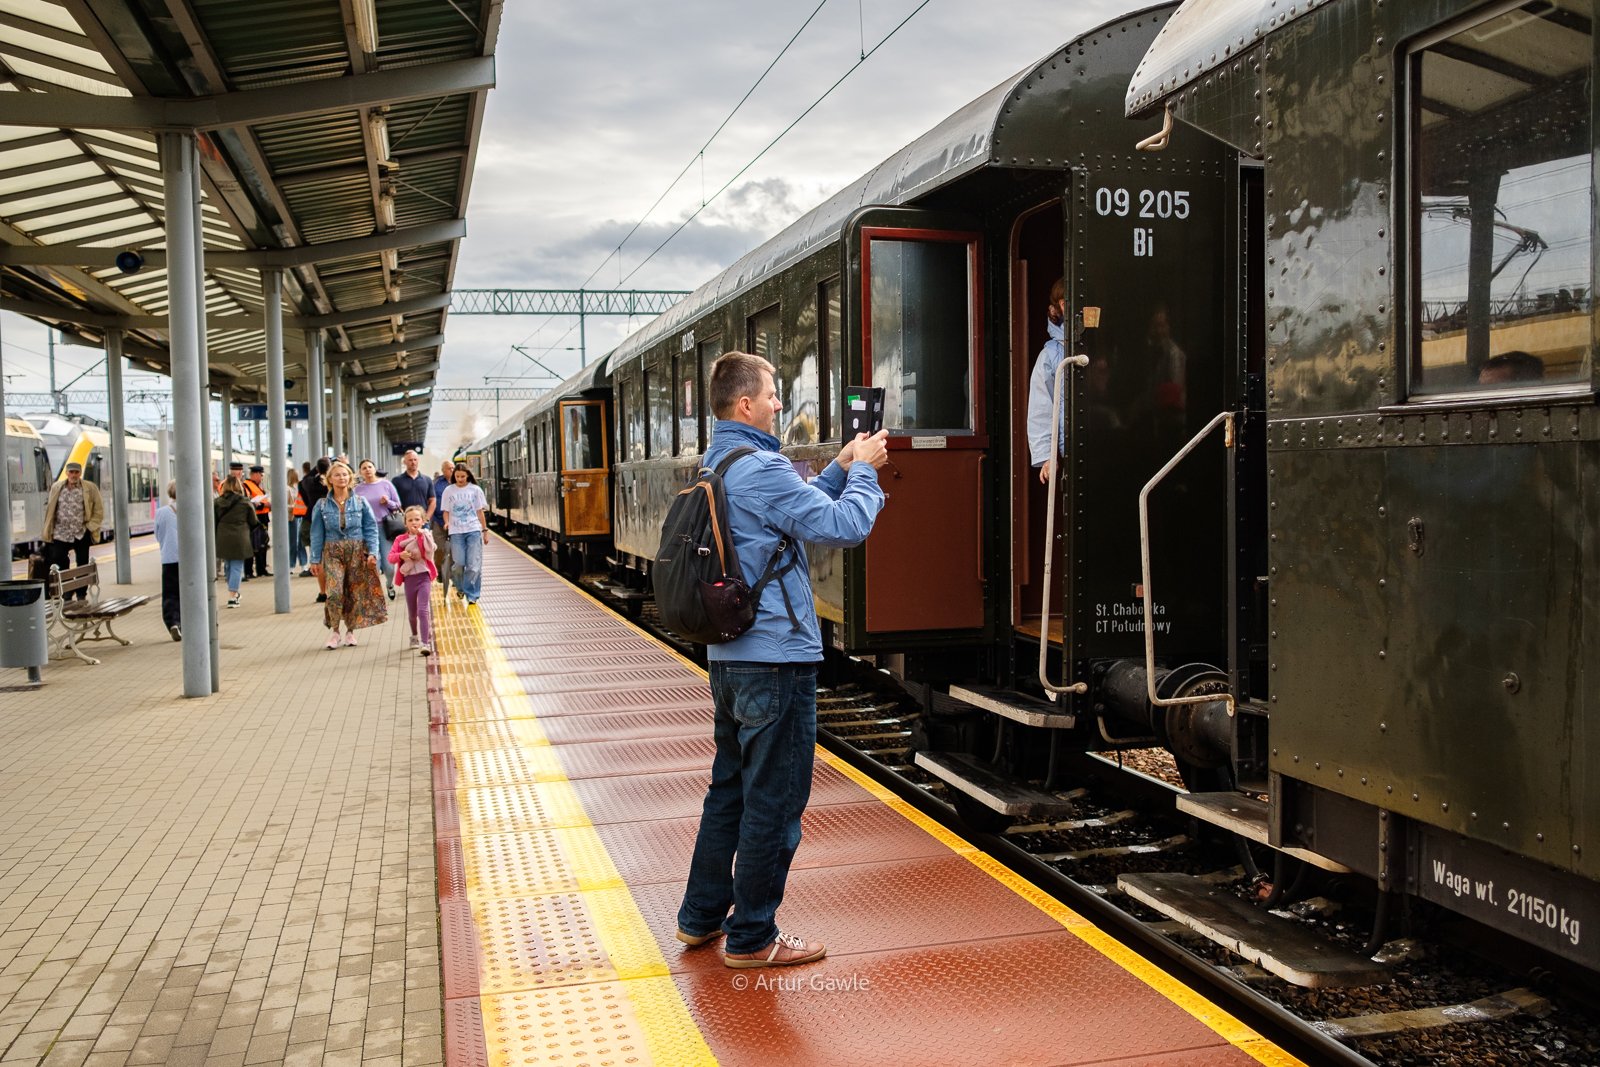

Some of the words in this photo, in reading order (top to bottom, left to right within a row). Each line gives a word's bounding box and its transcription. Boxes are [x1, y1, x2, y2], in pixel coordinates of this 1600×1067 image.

[1095, 187, 1130, 217] 09
[1139, 189, 1190, 220] 205
[1133, 227, 1153, 257] Bi
[243, 408, 250, 418] 7
[293, 408, 299, 417] 3
[1095, 603, 1110, 617] St.
[1113, 602, 1166, 616] Chabóka
[1095, 620, 1108, 633] CT
[1433, 859, 1470, 897] Waga
[1475, 880, 1498, 906] wt.
[1507, 889, 1557, 929] 21150
